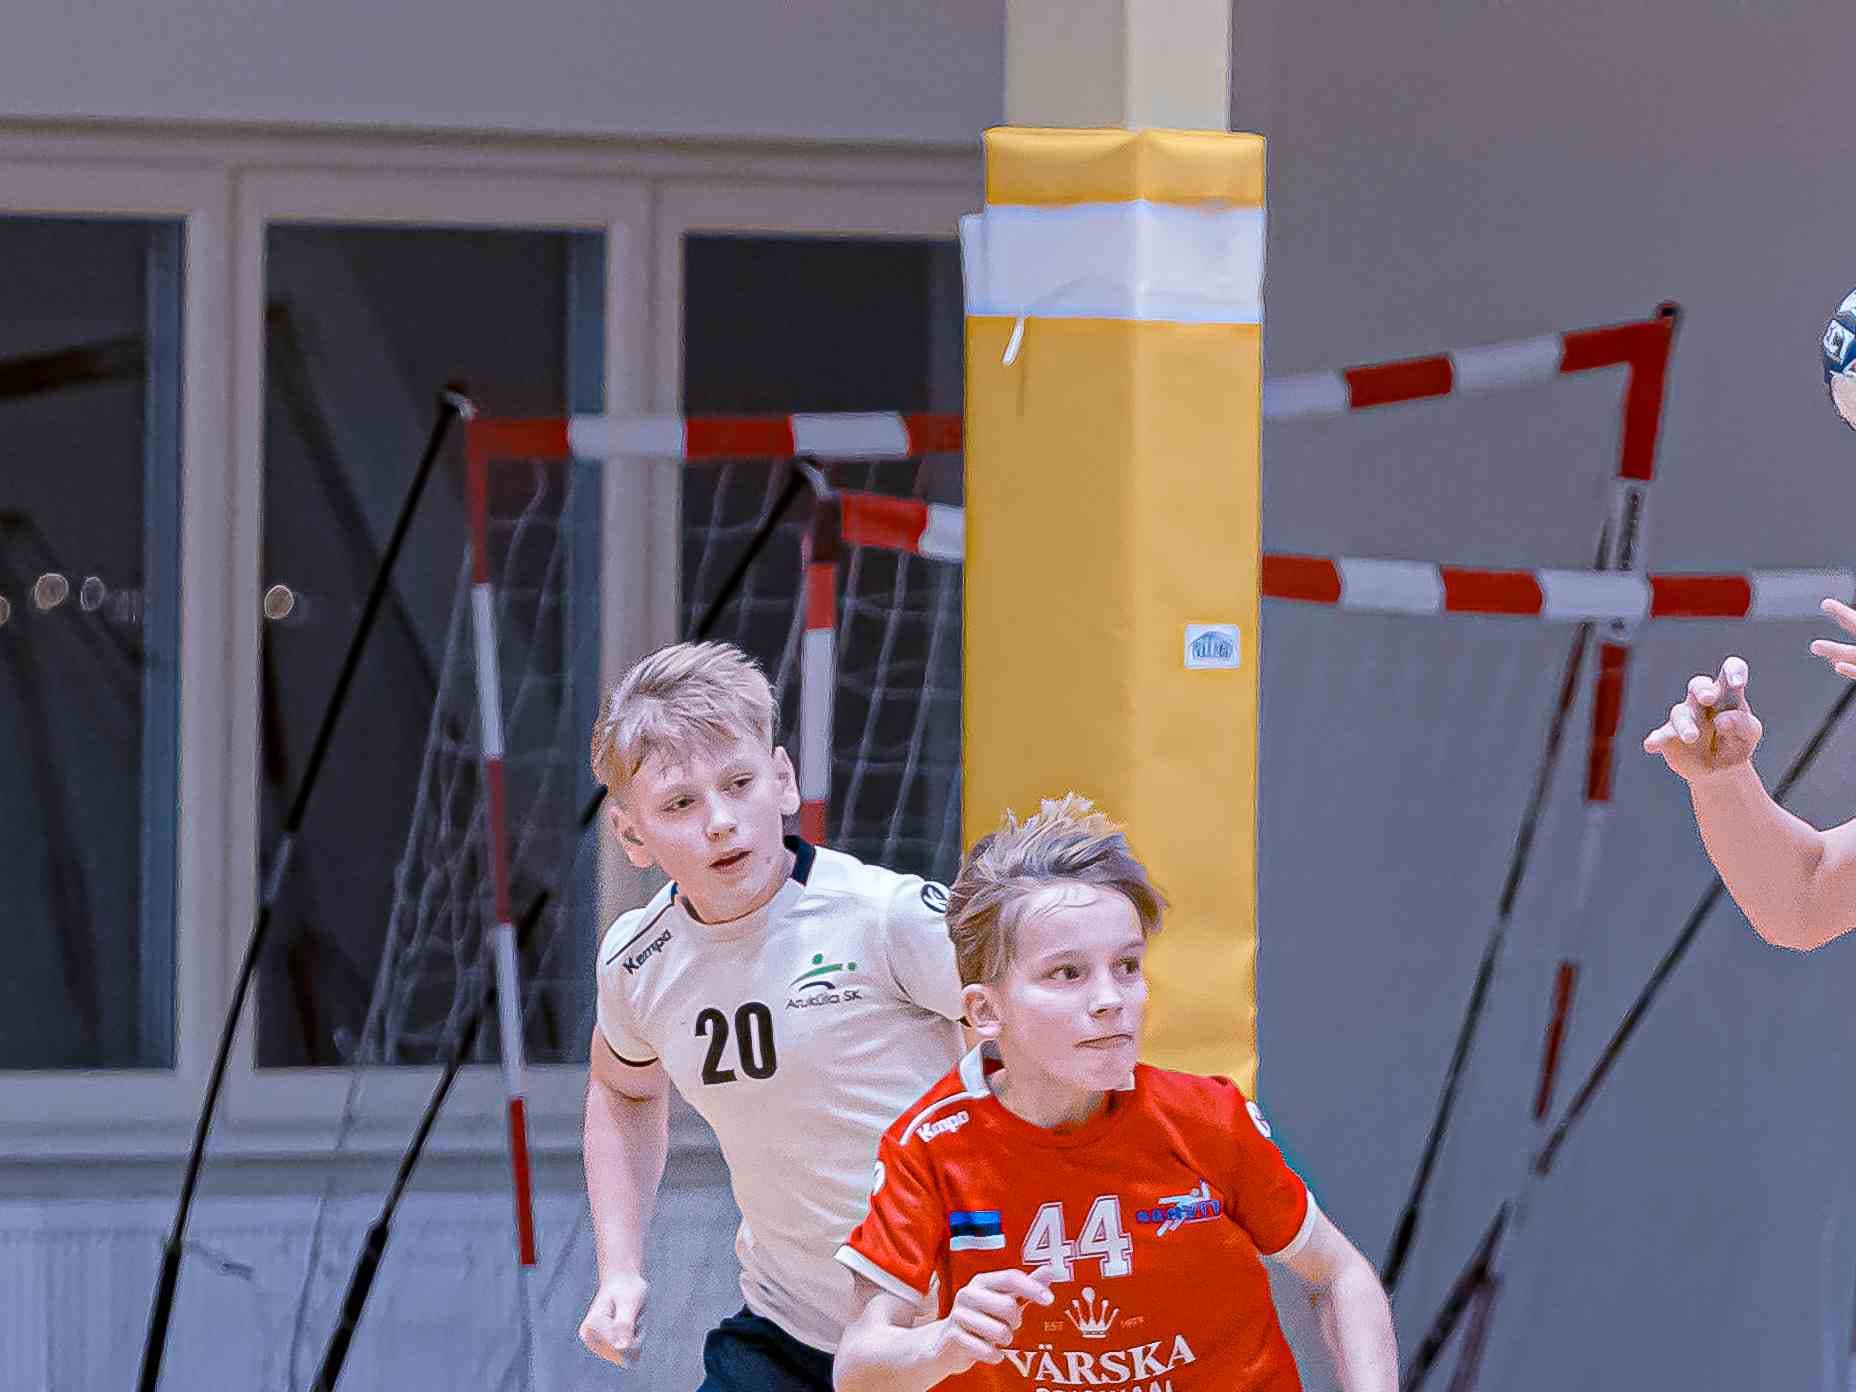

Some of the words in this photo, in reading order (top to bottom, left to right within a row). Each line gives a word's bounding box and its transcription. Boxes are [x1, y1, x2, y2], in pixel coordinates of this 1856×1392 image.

[622, 929, 672, 975] Kempa
[843, 989, 863, 1002] SK
[694, 1001, 778, 1086] 20
[1022, 1195, 1134, 1283] 44
[1003, 1335, 1198, 1385] VÄRSKA
